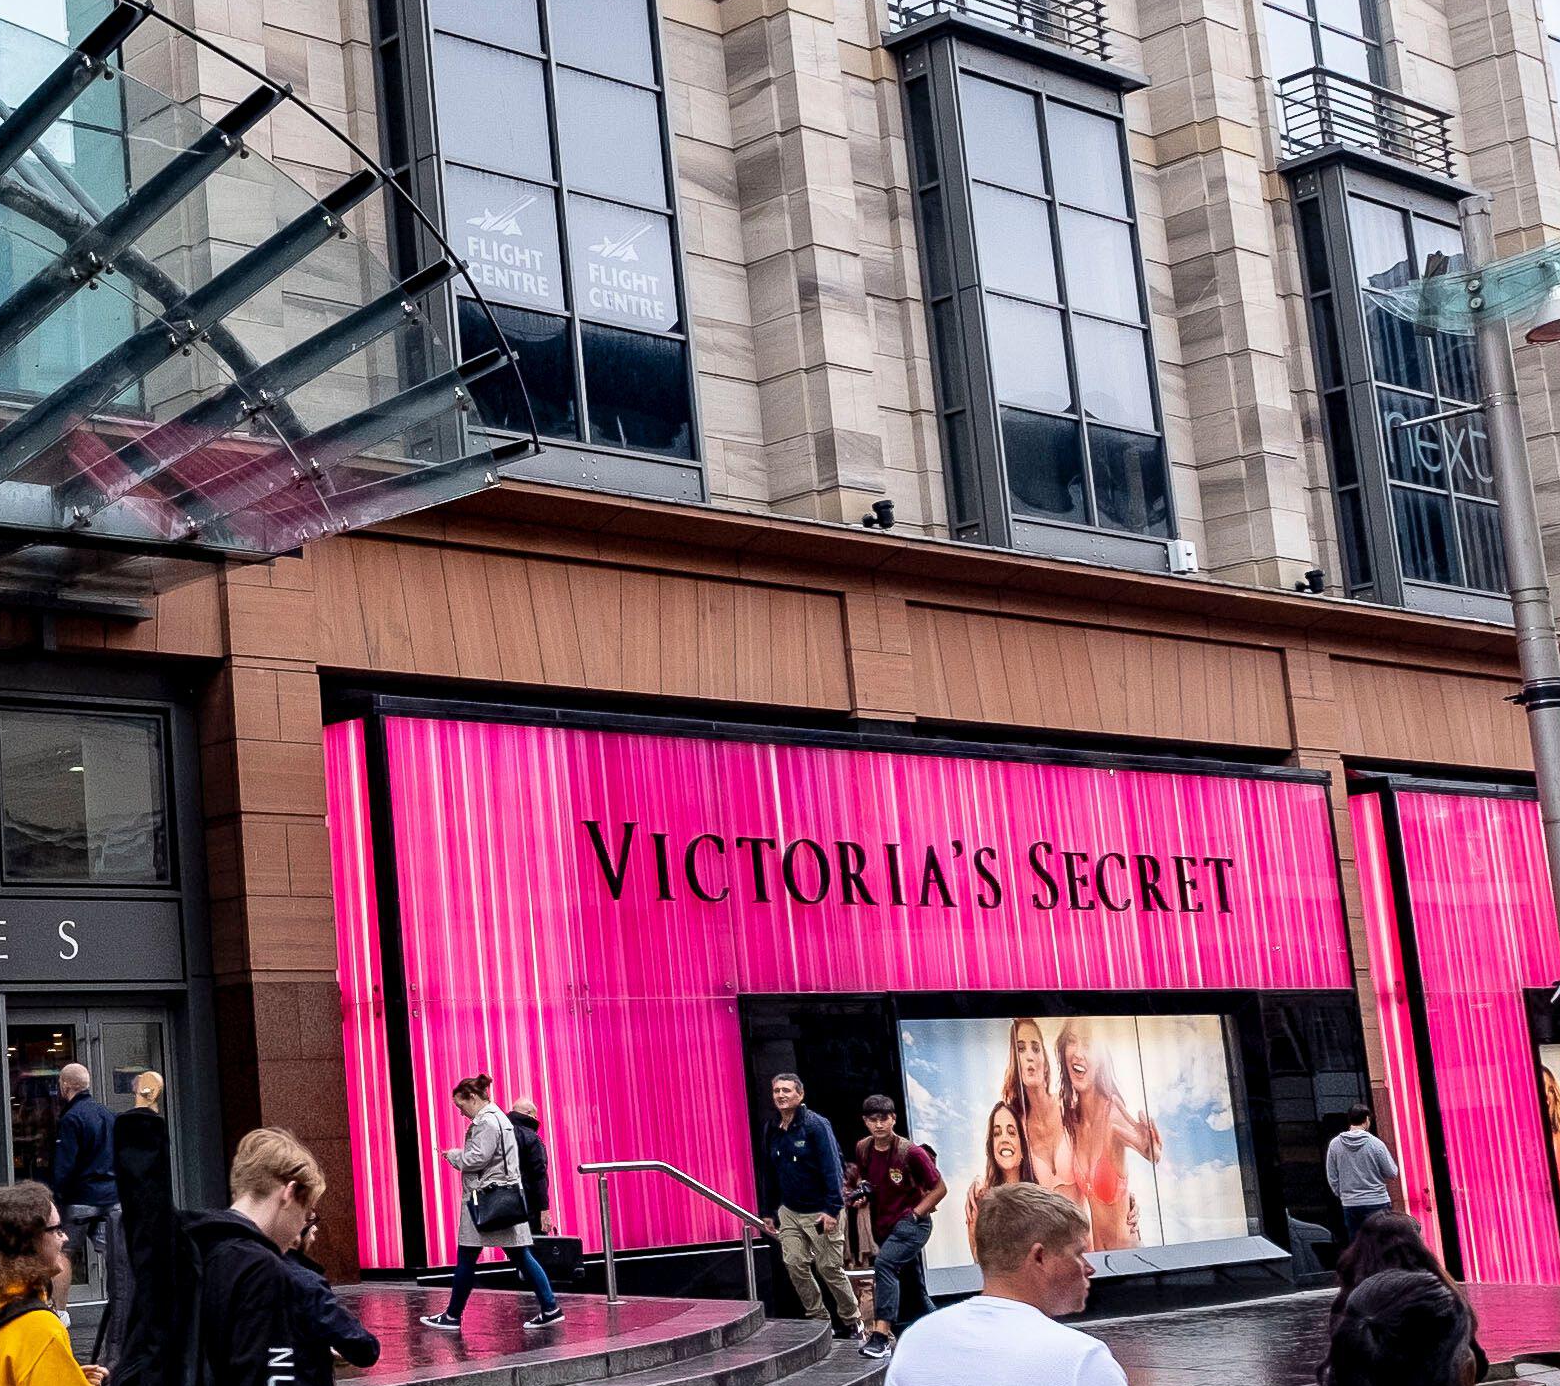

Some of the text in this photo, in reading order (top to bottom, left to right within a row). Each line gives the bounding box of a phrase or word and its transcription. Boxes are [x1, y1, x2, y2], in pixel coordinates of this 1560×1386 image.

[467, 236, 543, 272] FLIGHT
[470, 264, 549, 297] CENTRE
[587, 263, 659, 295] FLIGHT
[588, 287, 665, 321] CENTRE
[1384, 411, 1493, 484] next
[580, 820, 1235, 914] VICTORIA'S SECRET
